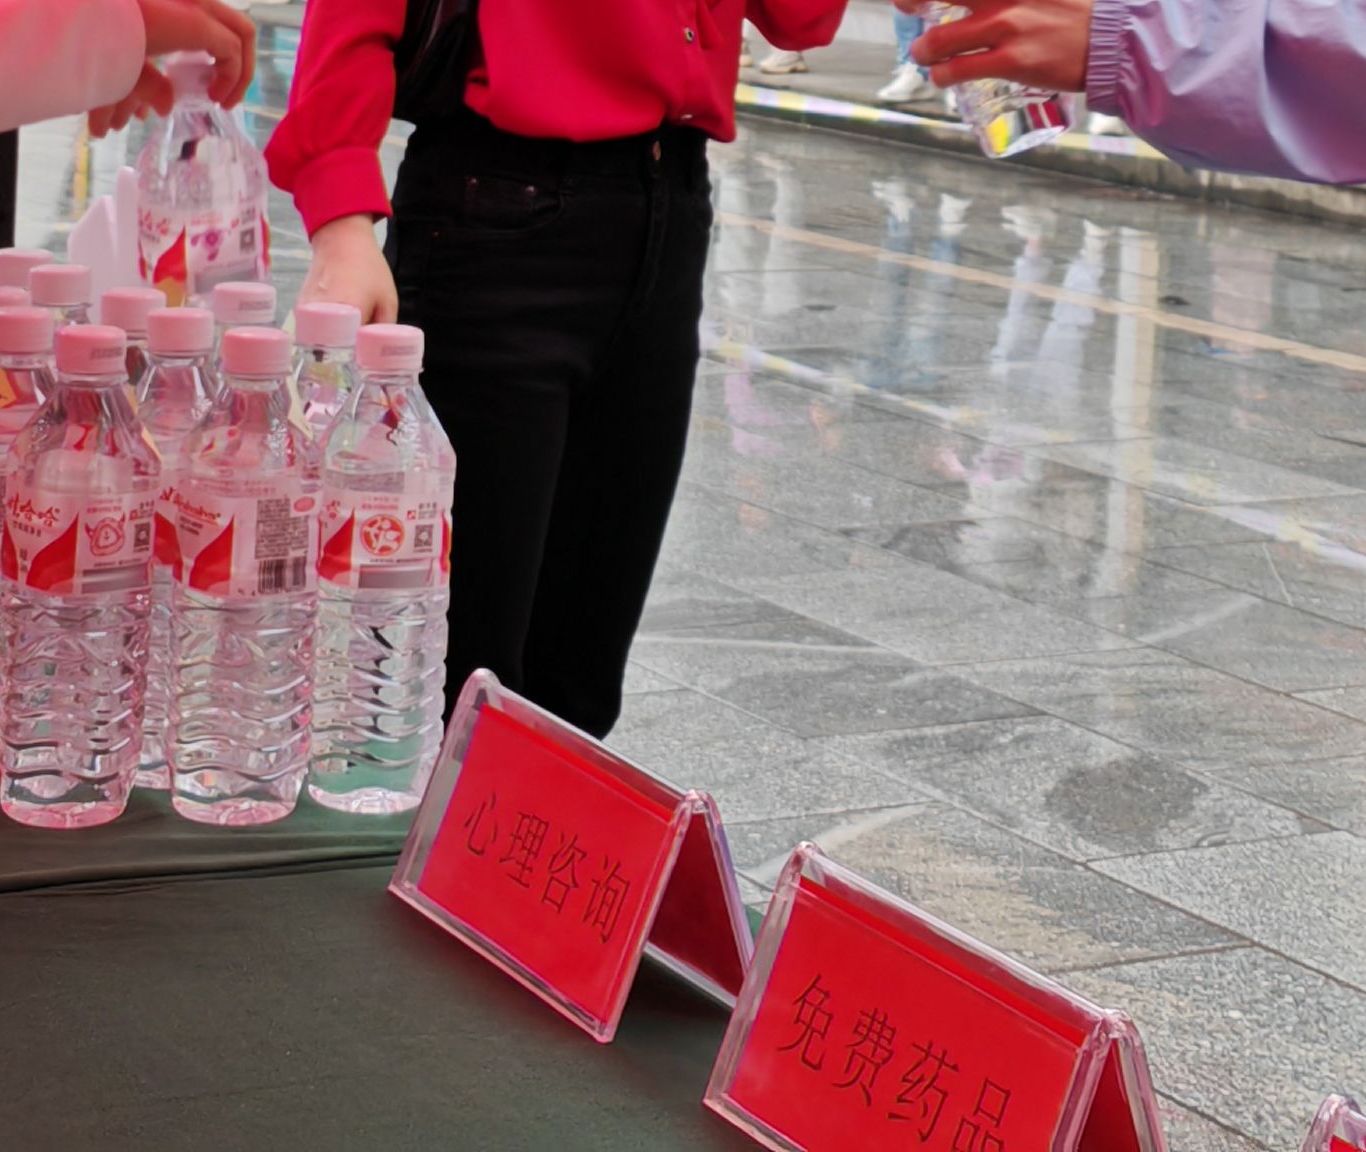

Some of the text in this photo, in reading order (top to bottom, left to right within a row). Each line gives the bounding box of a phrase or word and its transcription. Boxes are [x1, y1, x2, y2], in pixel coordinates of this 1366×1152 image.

[464, 792, 631, 944] 心理咨询
[777, 973, 1011, 1152] 免费药品
